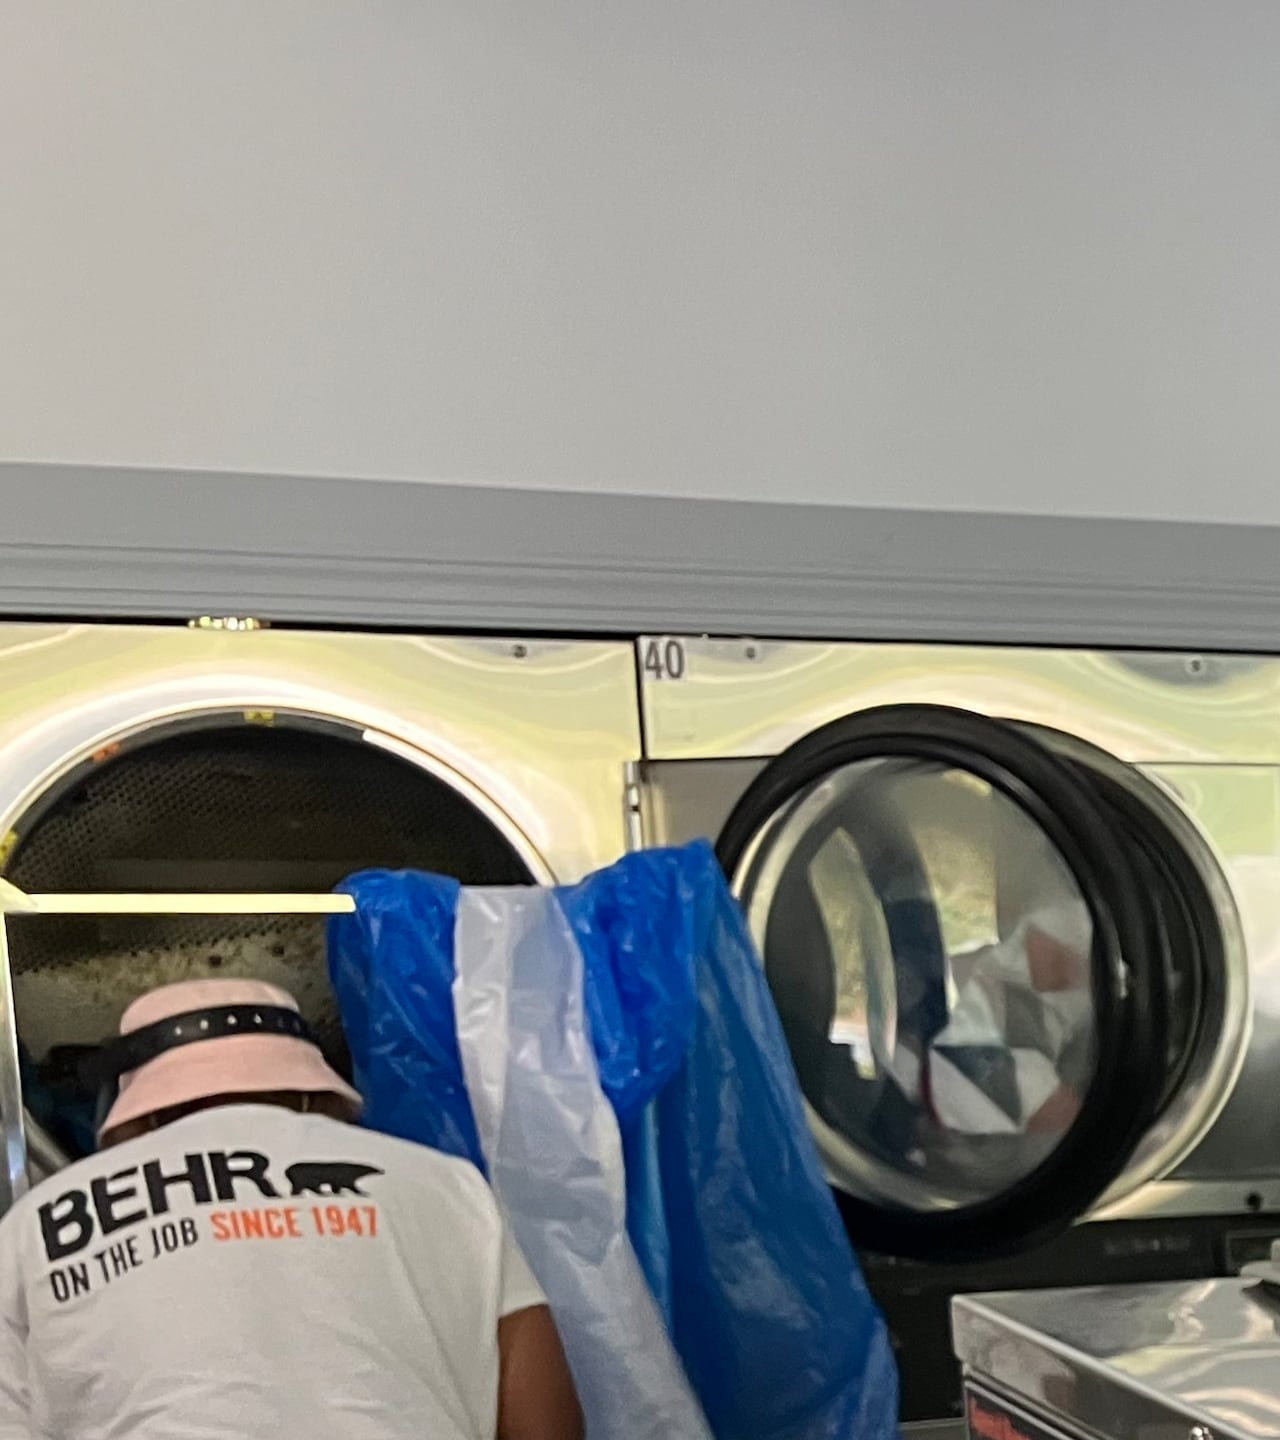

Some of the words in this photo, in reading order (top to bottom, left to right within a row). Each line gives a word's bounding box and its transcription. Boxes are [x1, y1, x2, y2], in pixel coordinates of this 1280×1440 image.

[645, 640, 685, 680] 40
[38, 1151, 282, 1262] BEHR
[50, 1267, 92, 1303] ON
[94, 1236, 143, 1285] THE
[151, 1216, 200, 1258] JOB
[209, 1205, 301, 1242] SINCE
[312, 1206, 379, 1239] 1947
